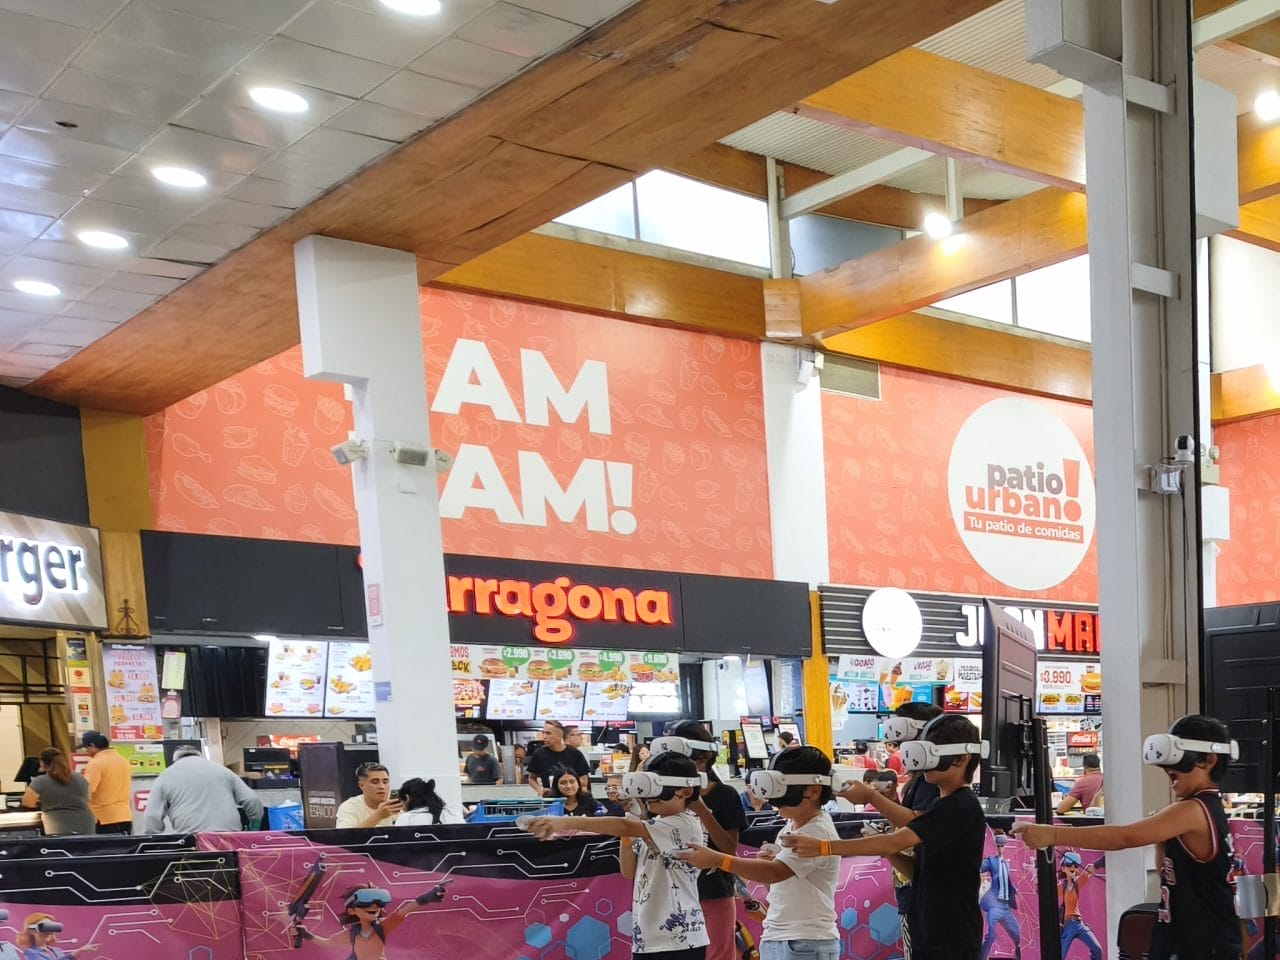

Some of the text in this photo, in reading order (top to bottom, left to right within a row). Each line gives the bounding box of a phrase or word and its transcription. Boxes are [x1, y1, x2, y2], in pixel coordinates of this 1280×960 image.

[430, 338, 612, 435] AM
[439, 443, 637, 535] AM!
[968, 516, 1080, 540] Tu patio de comidas
[447, 576, 673, 643] rragona
[1048, 609, 1101, 652] MA
